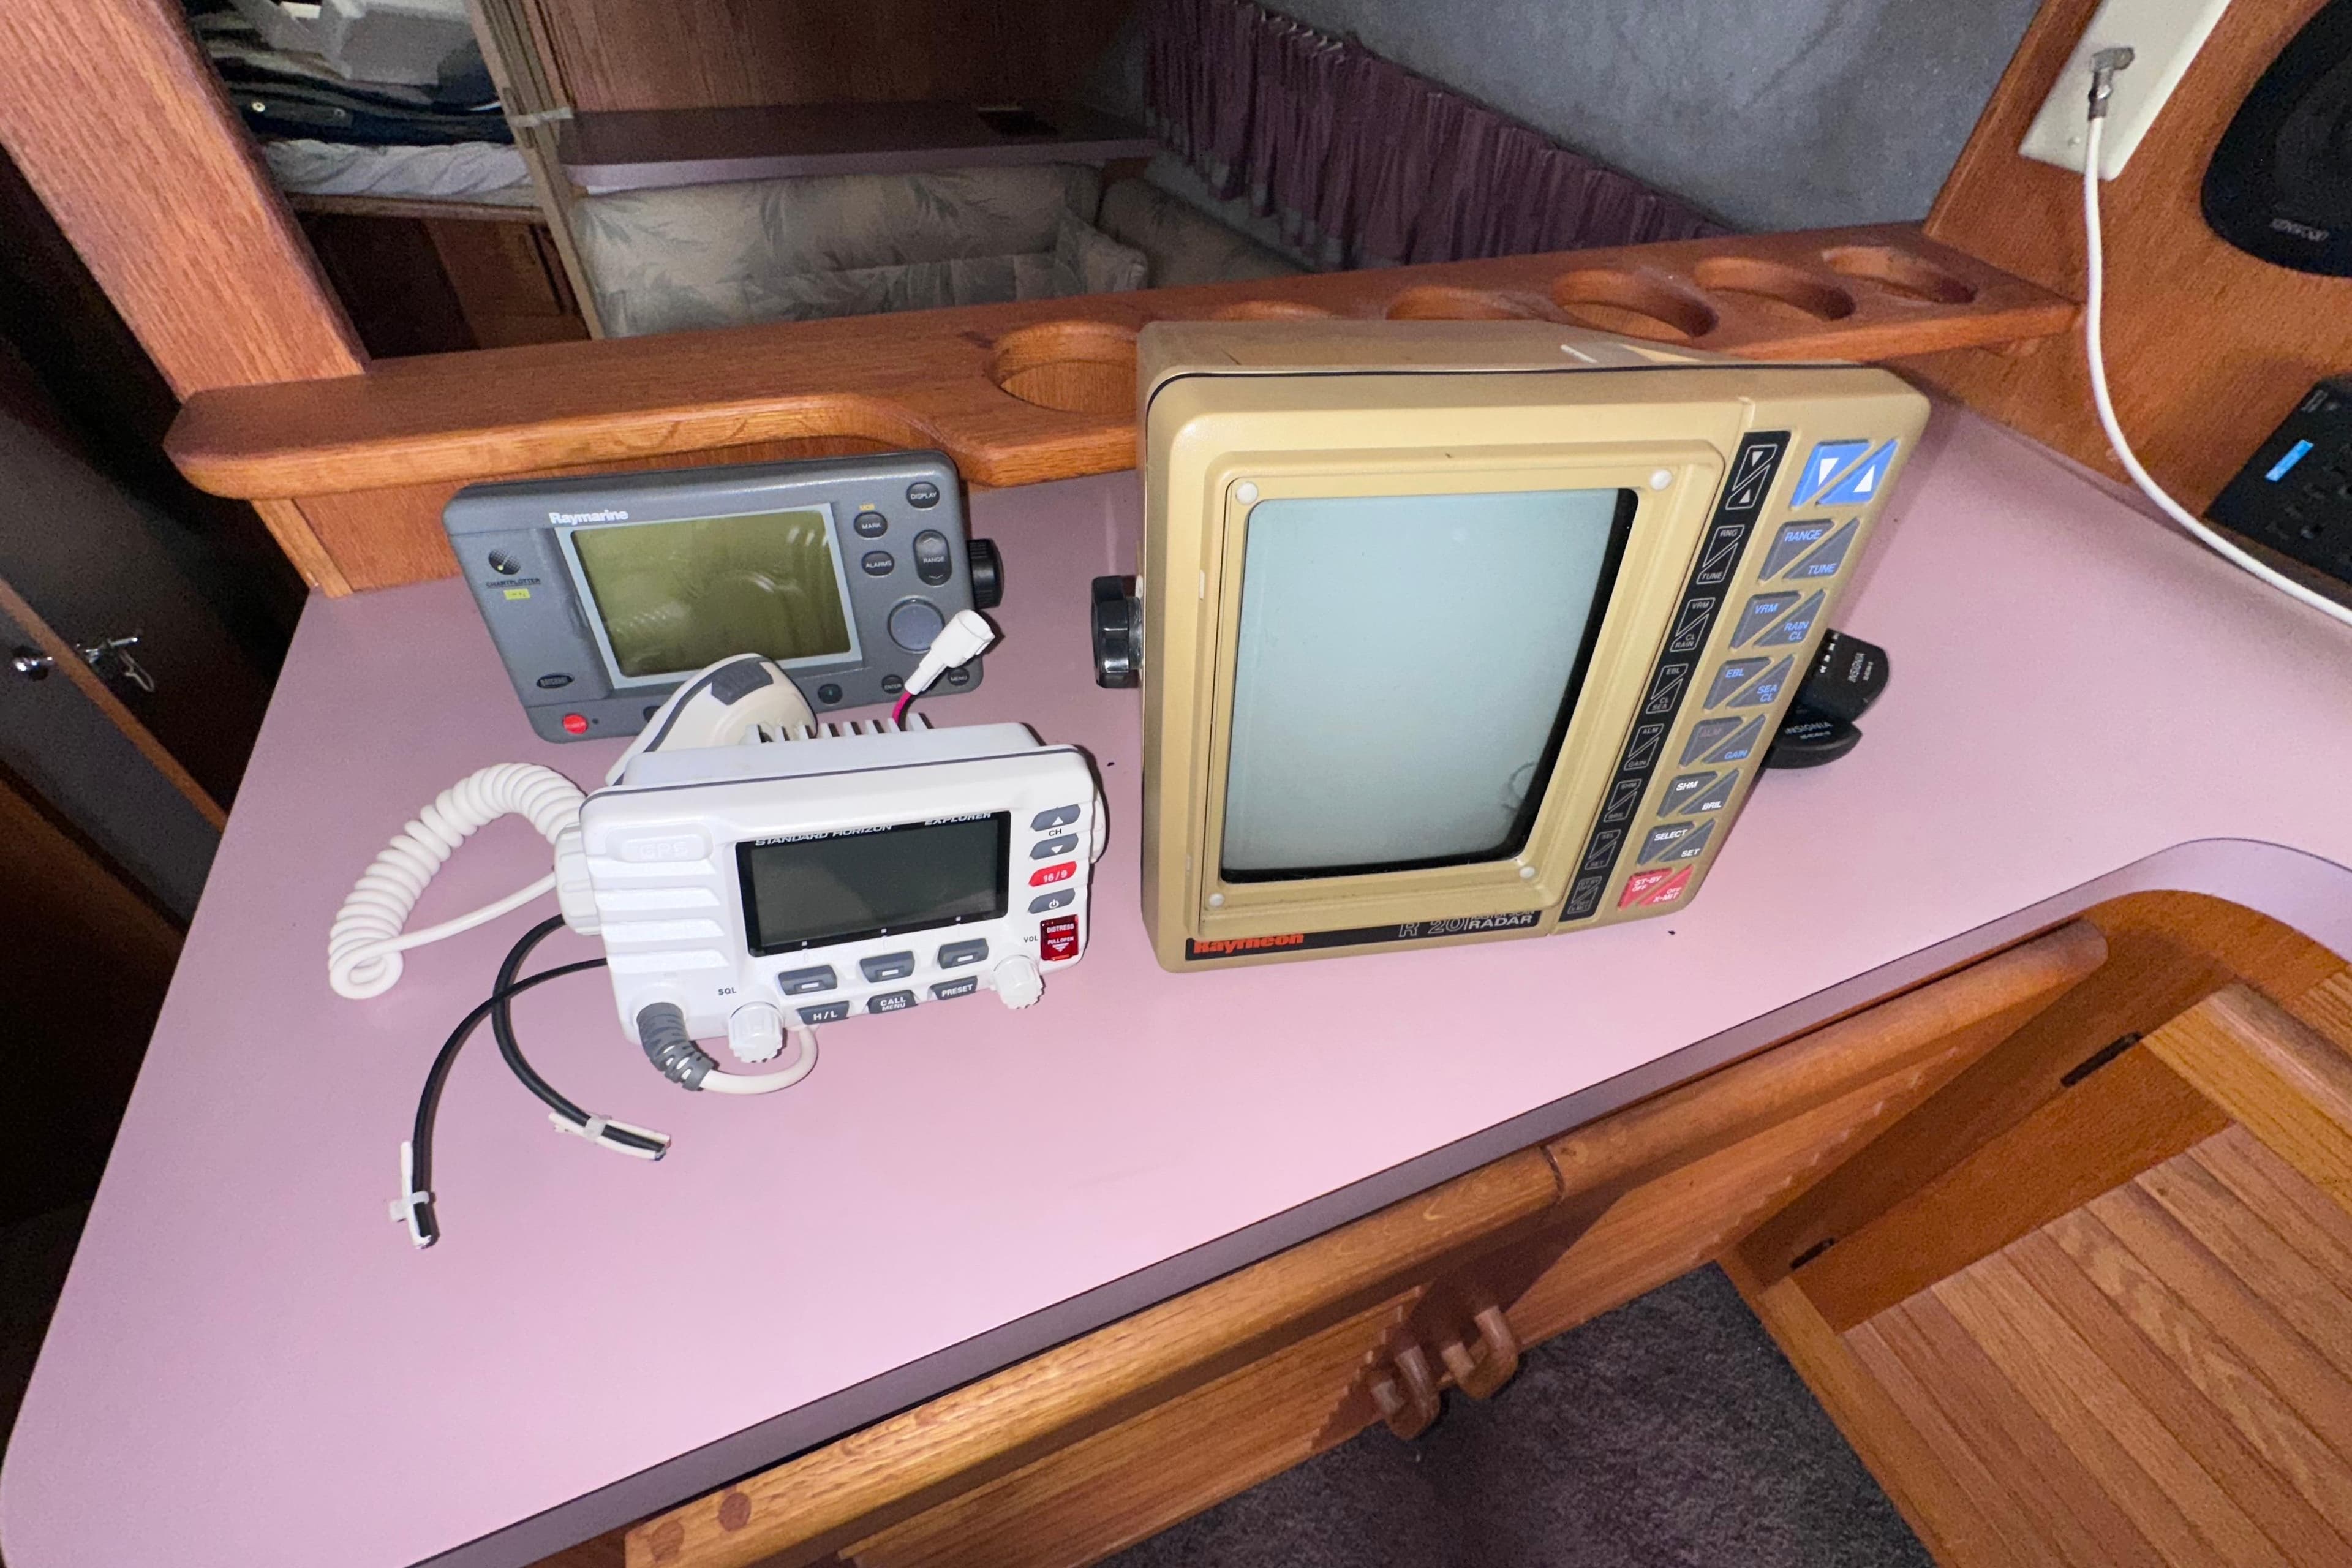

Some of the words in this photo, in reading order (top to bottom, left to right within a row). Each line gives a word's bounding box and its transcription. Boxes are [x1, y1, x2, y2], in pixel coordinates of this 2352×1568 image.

[548, 509, 629, 525] Raymarine
[1784, 529, 1823, 542] RANGE
[1807, 563, 1838, 575] TUNE
[1702, 571, 1722, 580] TUNE
[1754, 603, 1779, 614] VRM
[1784, 620, 1809, 631] RAIN
[1789, 631, 1803, 641] CL
[1724, 668, 1744, 679] EBL
[1757, 684, 1777, 695] SEA
[1759, 694, 1774, 703] CL
[1724, 749, 1748, 760] GAIN
[1676, 780, 1699, 791] SHM
[1701, 801, 1722, 811] BRIL
[925, 812, 992, 826] EXPLORER
[755, 832, 828, 846] STANDARD
[832, 824, 893, 837] HORIZON
[1654, 828, 1689, 841] SELECT
[1680, 848, 1700, 858] SET
[1634, 876, 1662, 886] ST-BY
[1653, 892, 1679, 903] X-MIT
[1046, 923, 1075, 933] DISTRESS
[1468, 915, 1533, 930] RADAR
[1023, 935, 1039, 943] VOL
[718, 987, 737, 995] SQL
[941, 984, 973, 997] PRESET
[880, 996, 907, 1006] CALL
[881, 1003, 907, 1011] MENU
[813, 1010, 839, 1021] H/L
